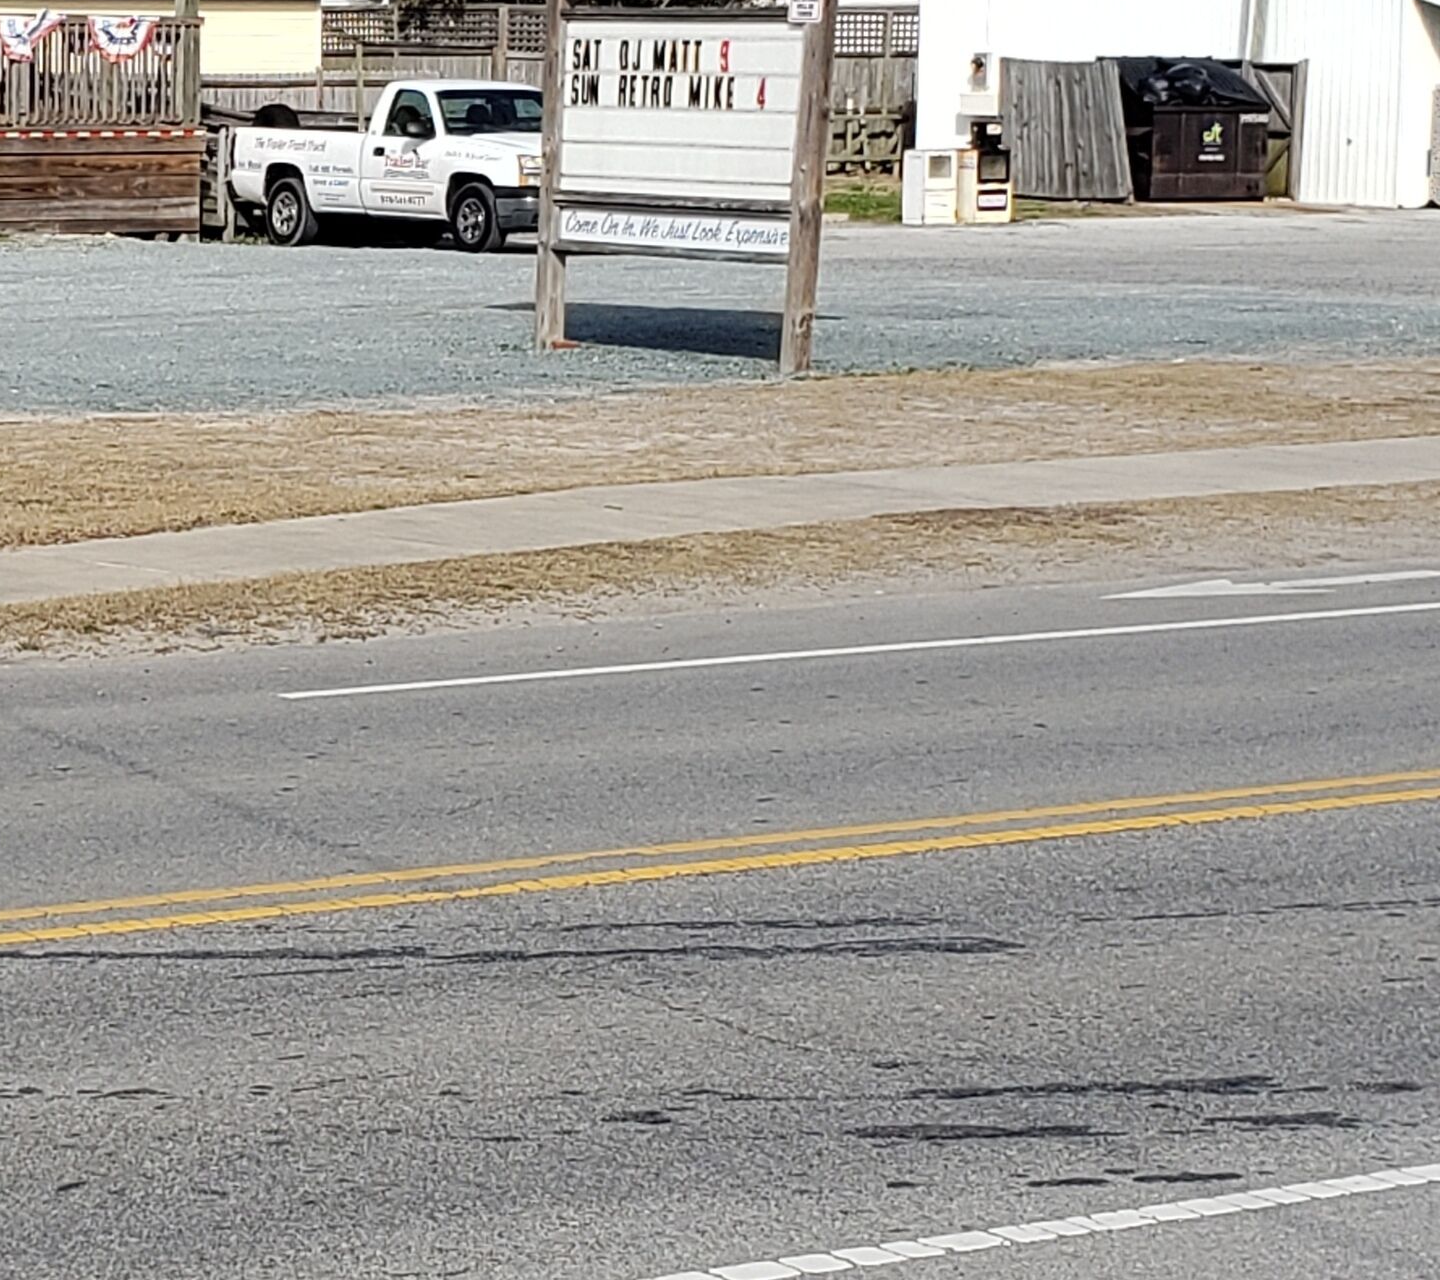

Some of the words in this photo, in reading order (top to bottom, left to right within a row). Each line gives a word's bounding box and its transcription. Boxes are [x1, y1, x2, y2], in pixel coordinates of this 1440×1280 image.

[572, 39, 601, 71] SAT
[619, 39, 642, 71] DJ
[653, 40, 702, 73] MATT
[720, 40, 730, 73] 9
[571, 74, 600, 107] SUN
[618, 75, 673, 108] RETRO
[688, 75, 735, 110] MIKE
[756, 77, 766, 111] 4
[565, 210, 598, 234] Come
[601, 213, 618, 236] On
[640, 216, 659, 239] We
[661, 220, 691, 241] Just
[692, 220, 722, 242] Look
[725, 220, 789, 248] Expensive
